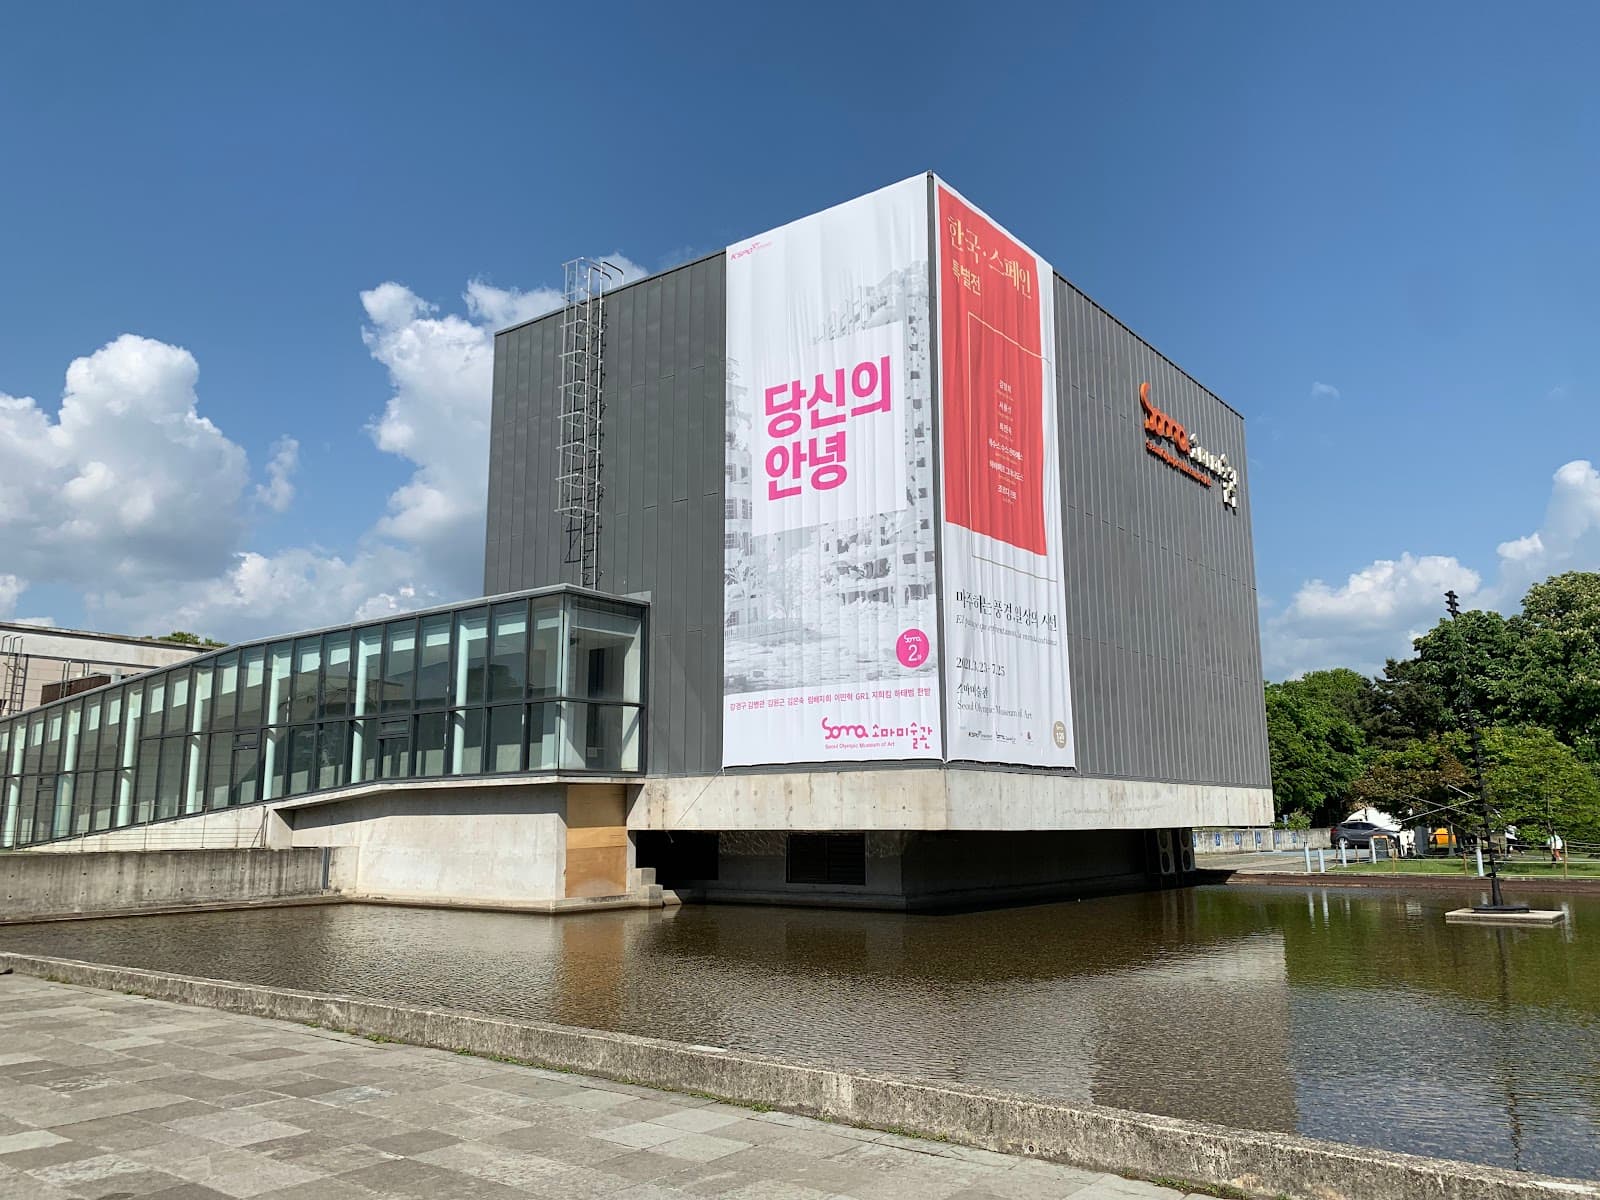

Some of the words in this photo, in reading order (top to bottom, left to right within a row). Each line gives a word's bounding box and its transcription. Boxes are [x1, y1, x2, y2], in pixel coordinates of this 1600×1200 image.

[952, 258, 981, 297] 특별전
[765, 355, 892, 439] 당신의
[765, 430, 848, 501] 안녕
[956, 588, 993, 616] 마주하는
[821, 716, 869, 740] Soma
[871, 721, 933, 750] 소마미술관
